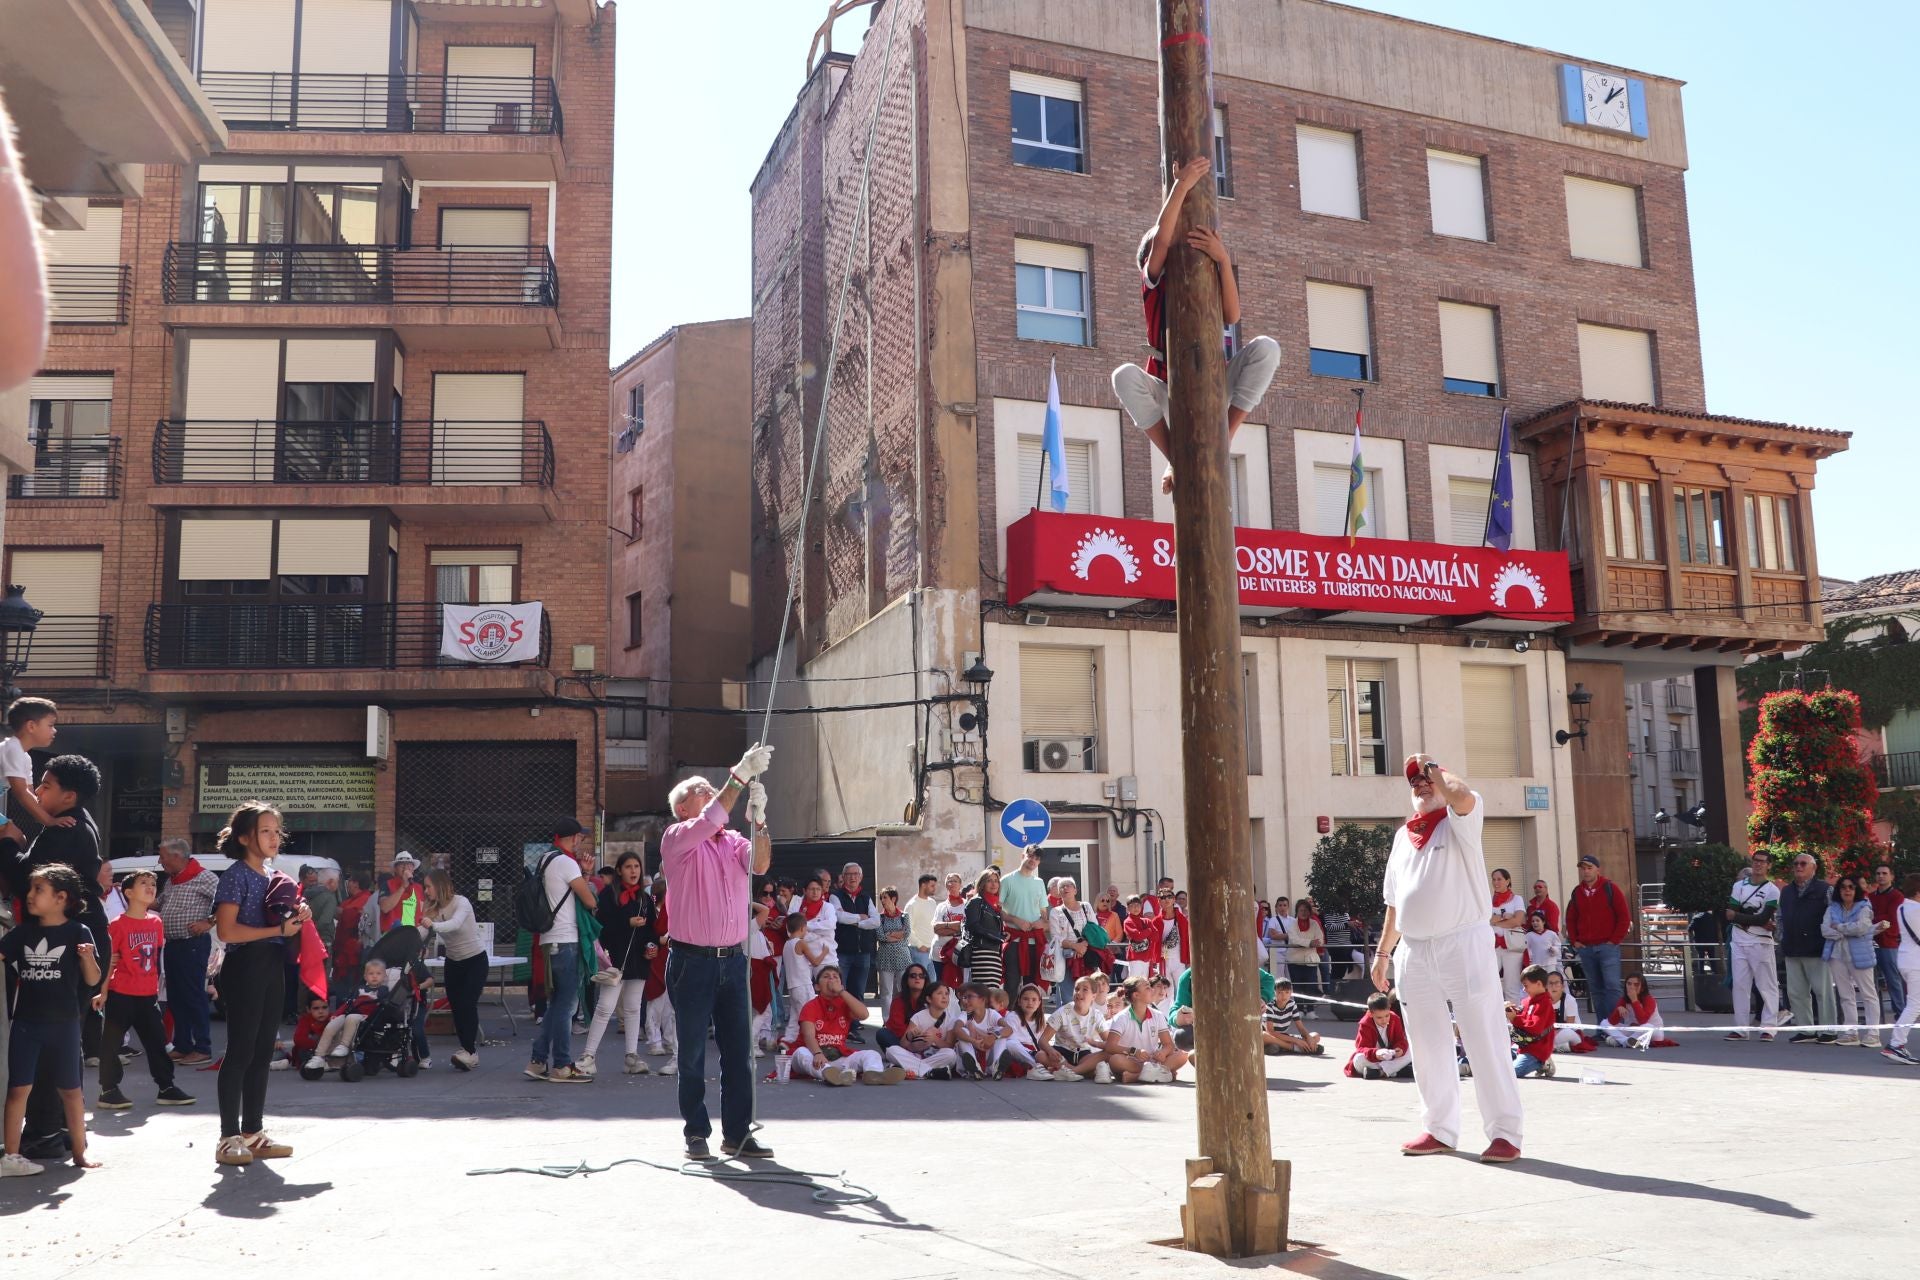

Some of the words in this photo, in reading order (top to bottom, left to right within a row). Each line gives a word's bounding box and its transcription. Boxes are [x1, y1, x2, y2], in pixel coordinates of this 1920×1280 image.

[1601, 78, 1608, 87] 12
[1235, 545, 1309, 577] OSME
[1313, 551, 1331, 578] Y
[1336, 552, 1386, 581] SAN
[1391, 553, 1480, 588] DAMIÁN
[1240, 576, 1258, 591] DE
[1393, 585, 1457, 603] NACIONAL
[479, 613, 507, 622] HOSPITAL
[167, 797, 177, 805] 13
[21, 968, 62, 981] adidas
